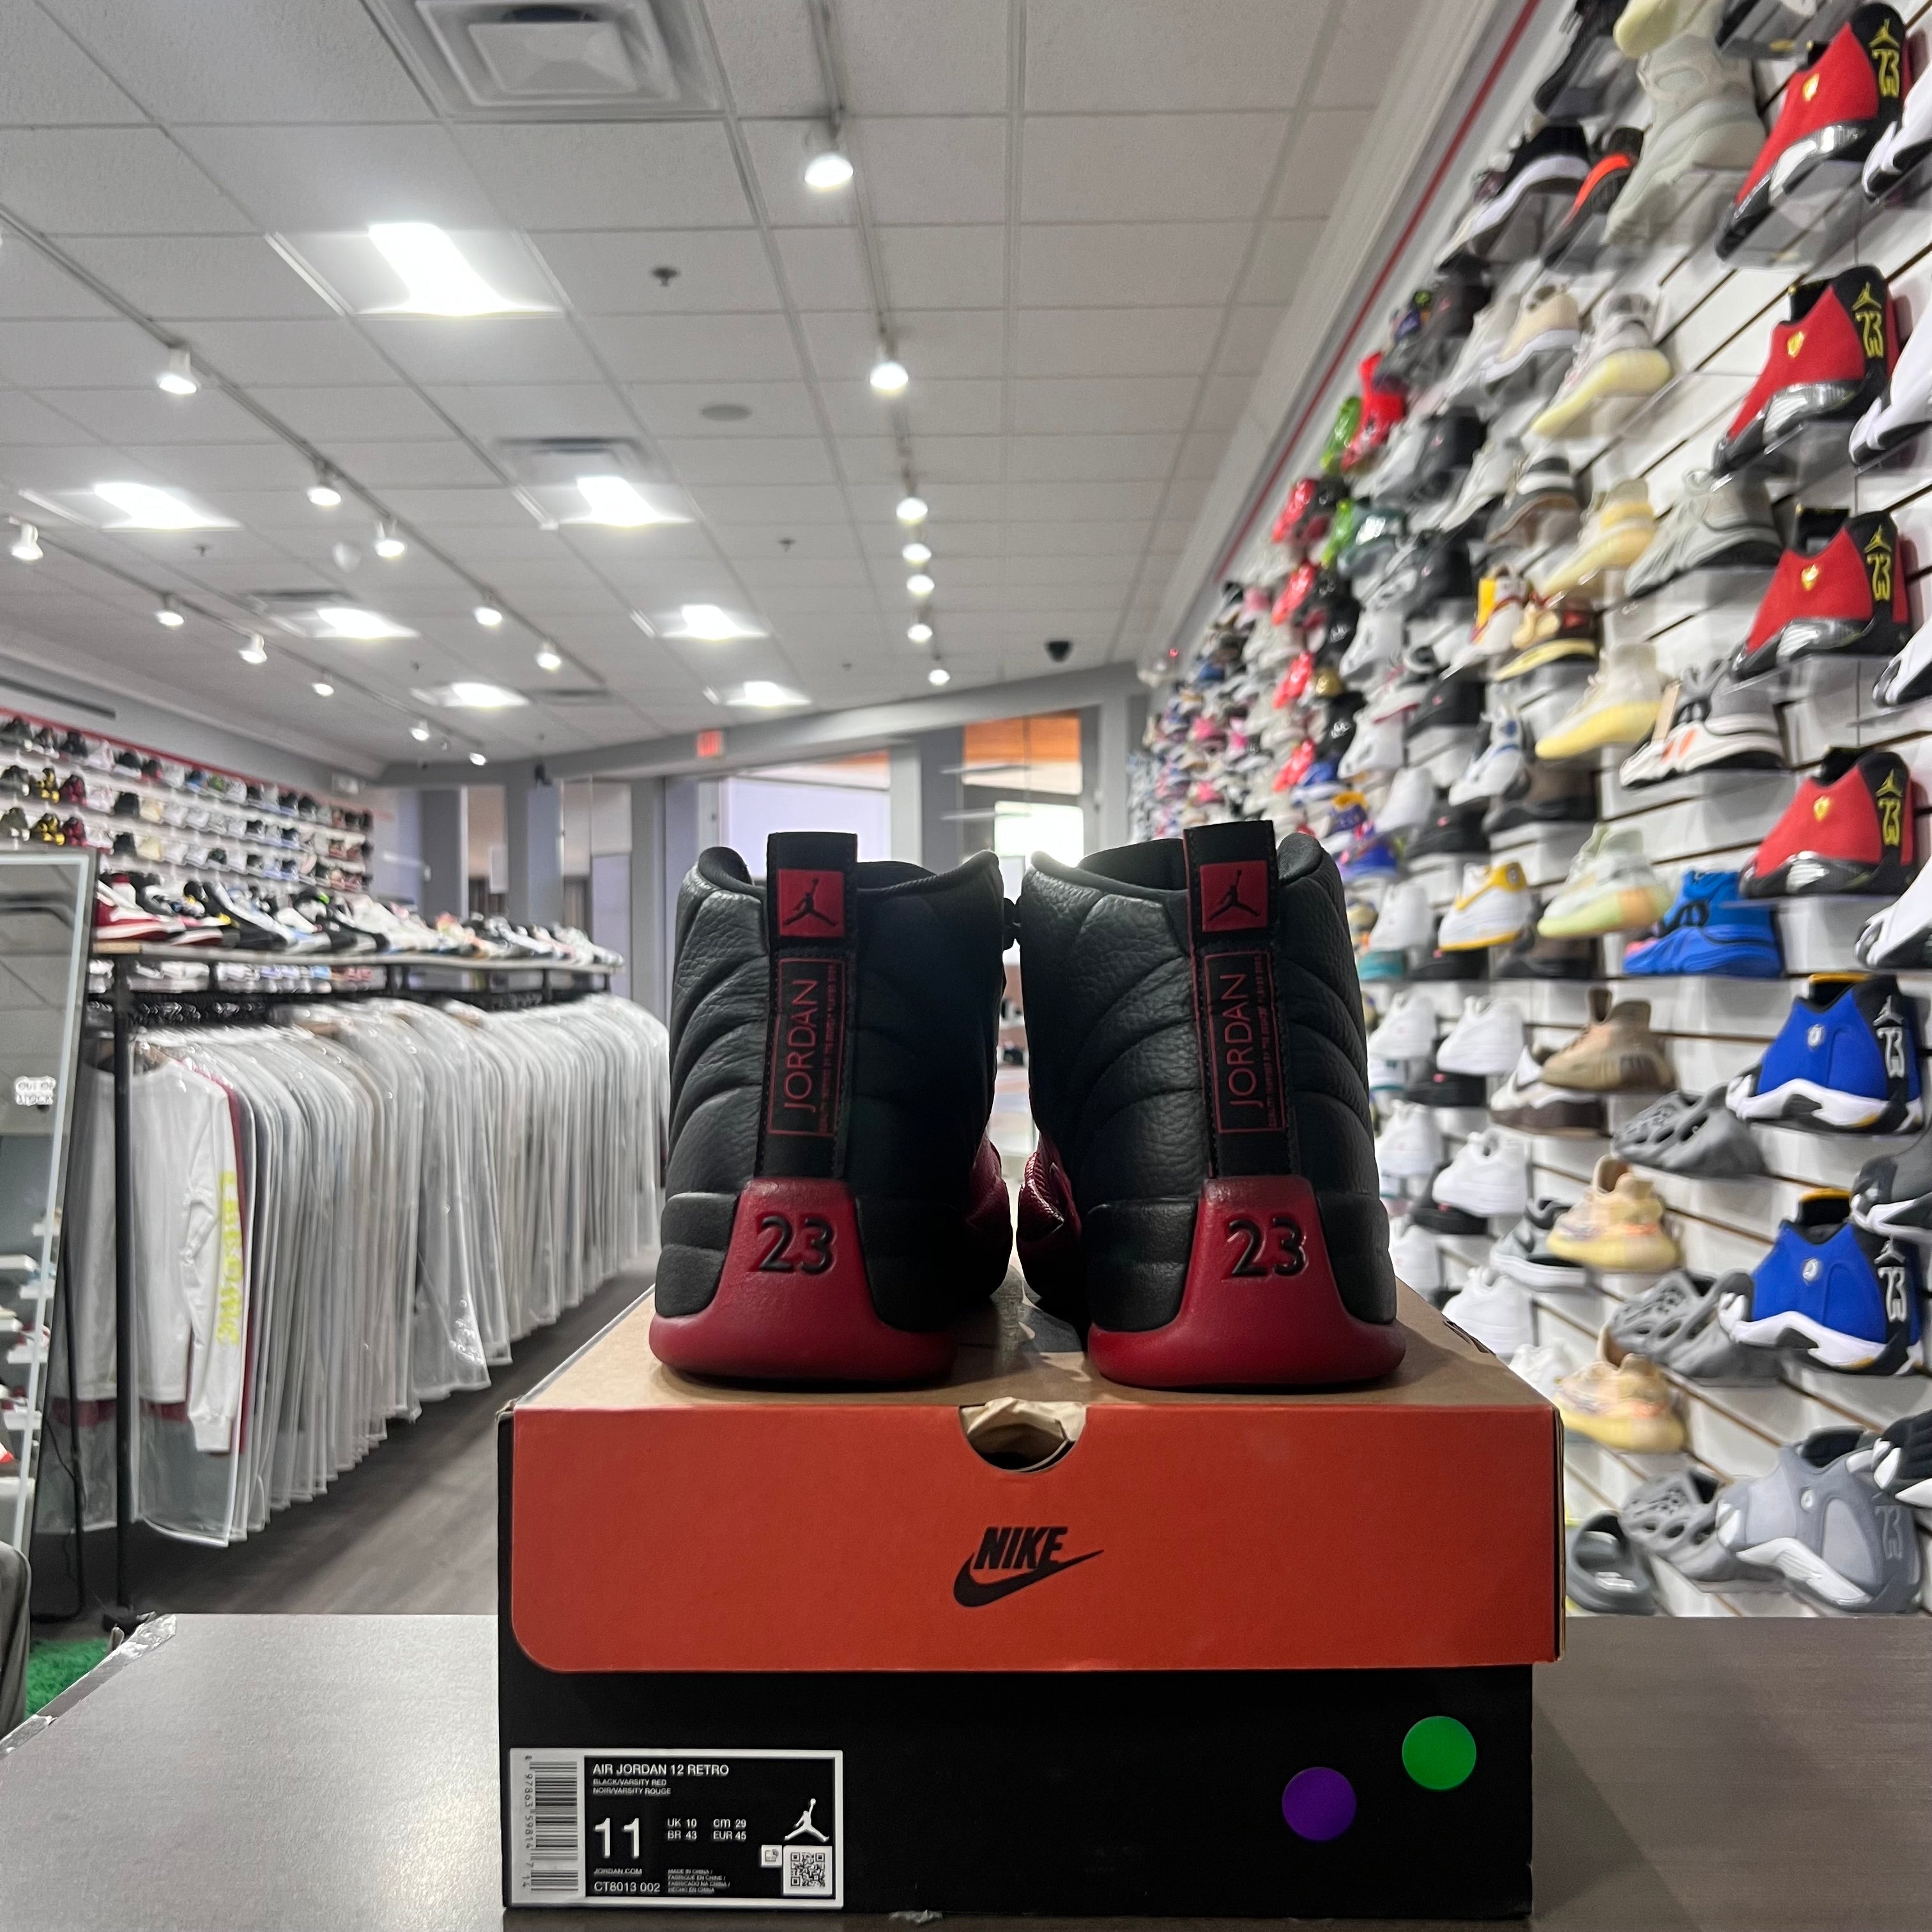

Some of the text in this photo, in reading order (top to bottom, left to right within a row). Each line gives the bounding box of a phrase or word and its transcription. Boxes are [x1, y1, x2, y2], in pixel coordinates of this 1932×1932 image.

[783, 979, 819, 1114] JORDAN
[1219, 973, 1264, 1108] JORDAN
[759, 1215, 835, 1276] 23
[1228, 1217, 1305, 1277] 23
[973, 1526, 1068, 1570] NIKE
[592, 1763, 730, 1776] AIR JORDAN 12 RETRO
[652, 1779, 667, 1787] RED
[525, 1774, 533, 1807] 97863
[645, 1788, 671, 1796] ROUGE
[667, 1818, 697, 1828] UK 10
[735, 1819, 747, 1828] 29
[594, 1818, 640, 1858] 11
[667, 1830, 697, 1841] BR 43
[713, 1831, 747, 1841] EUR 45
[594, 1867, 642, 1876] JORDAN.COM
[594, 1881, 661, 1892] CT8013 002
